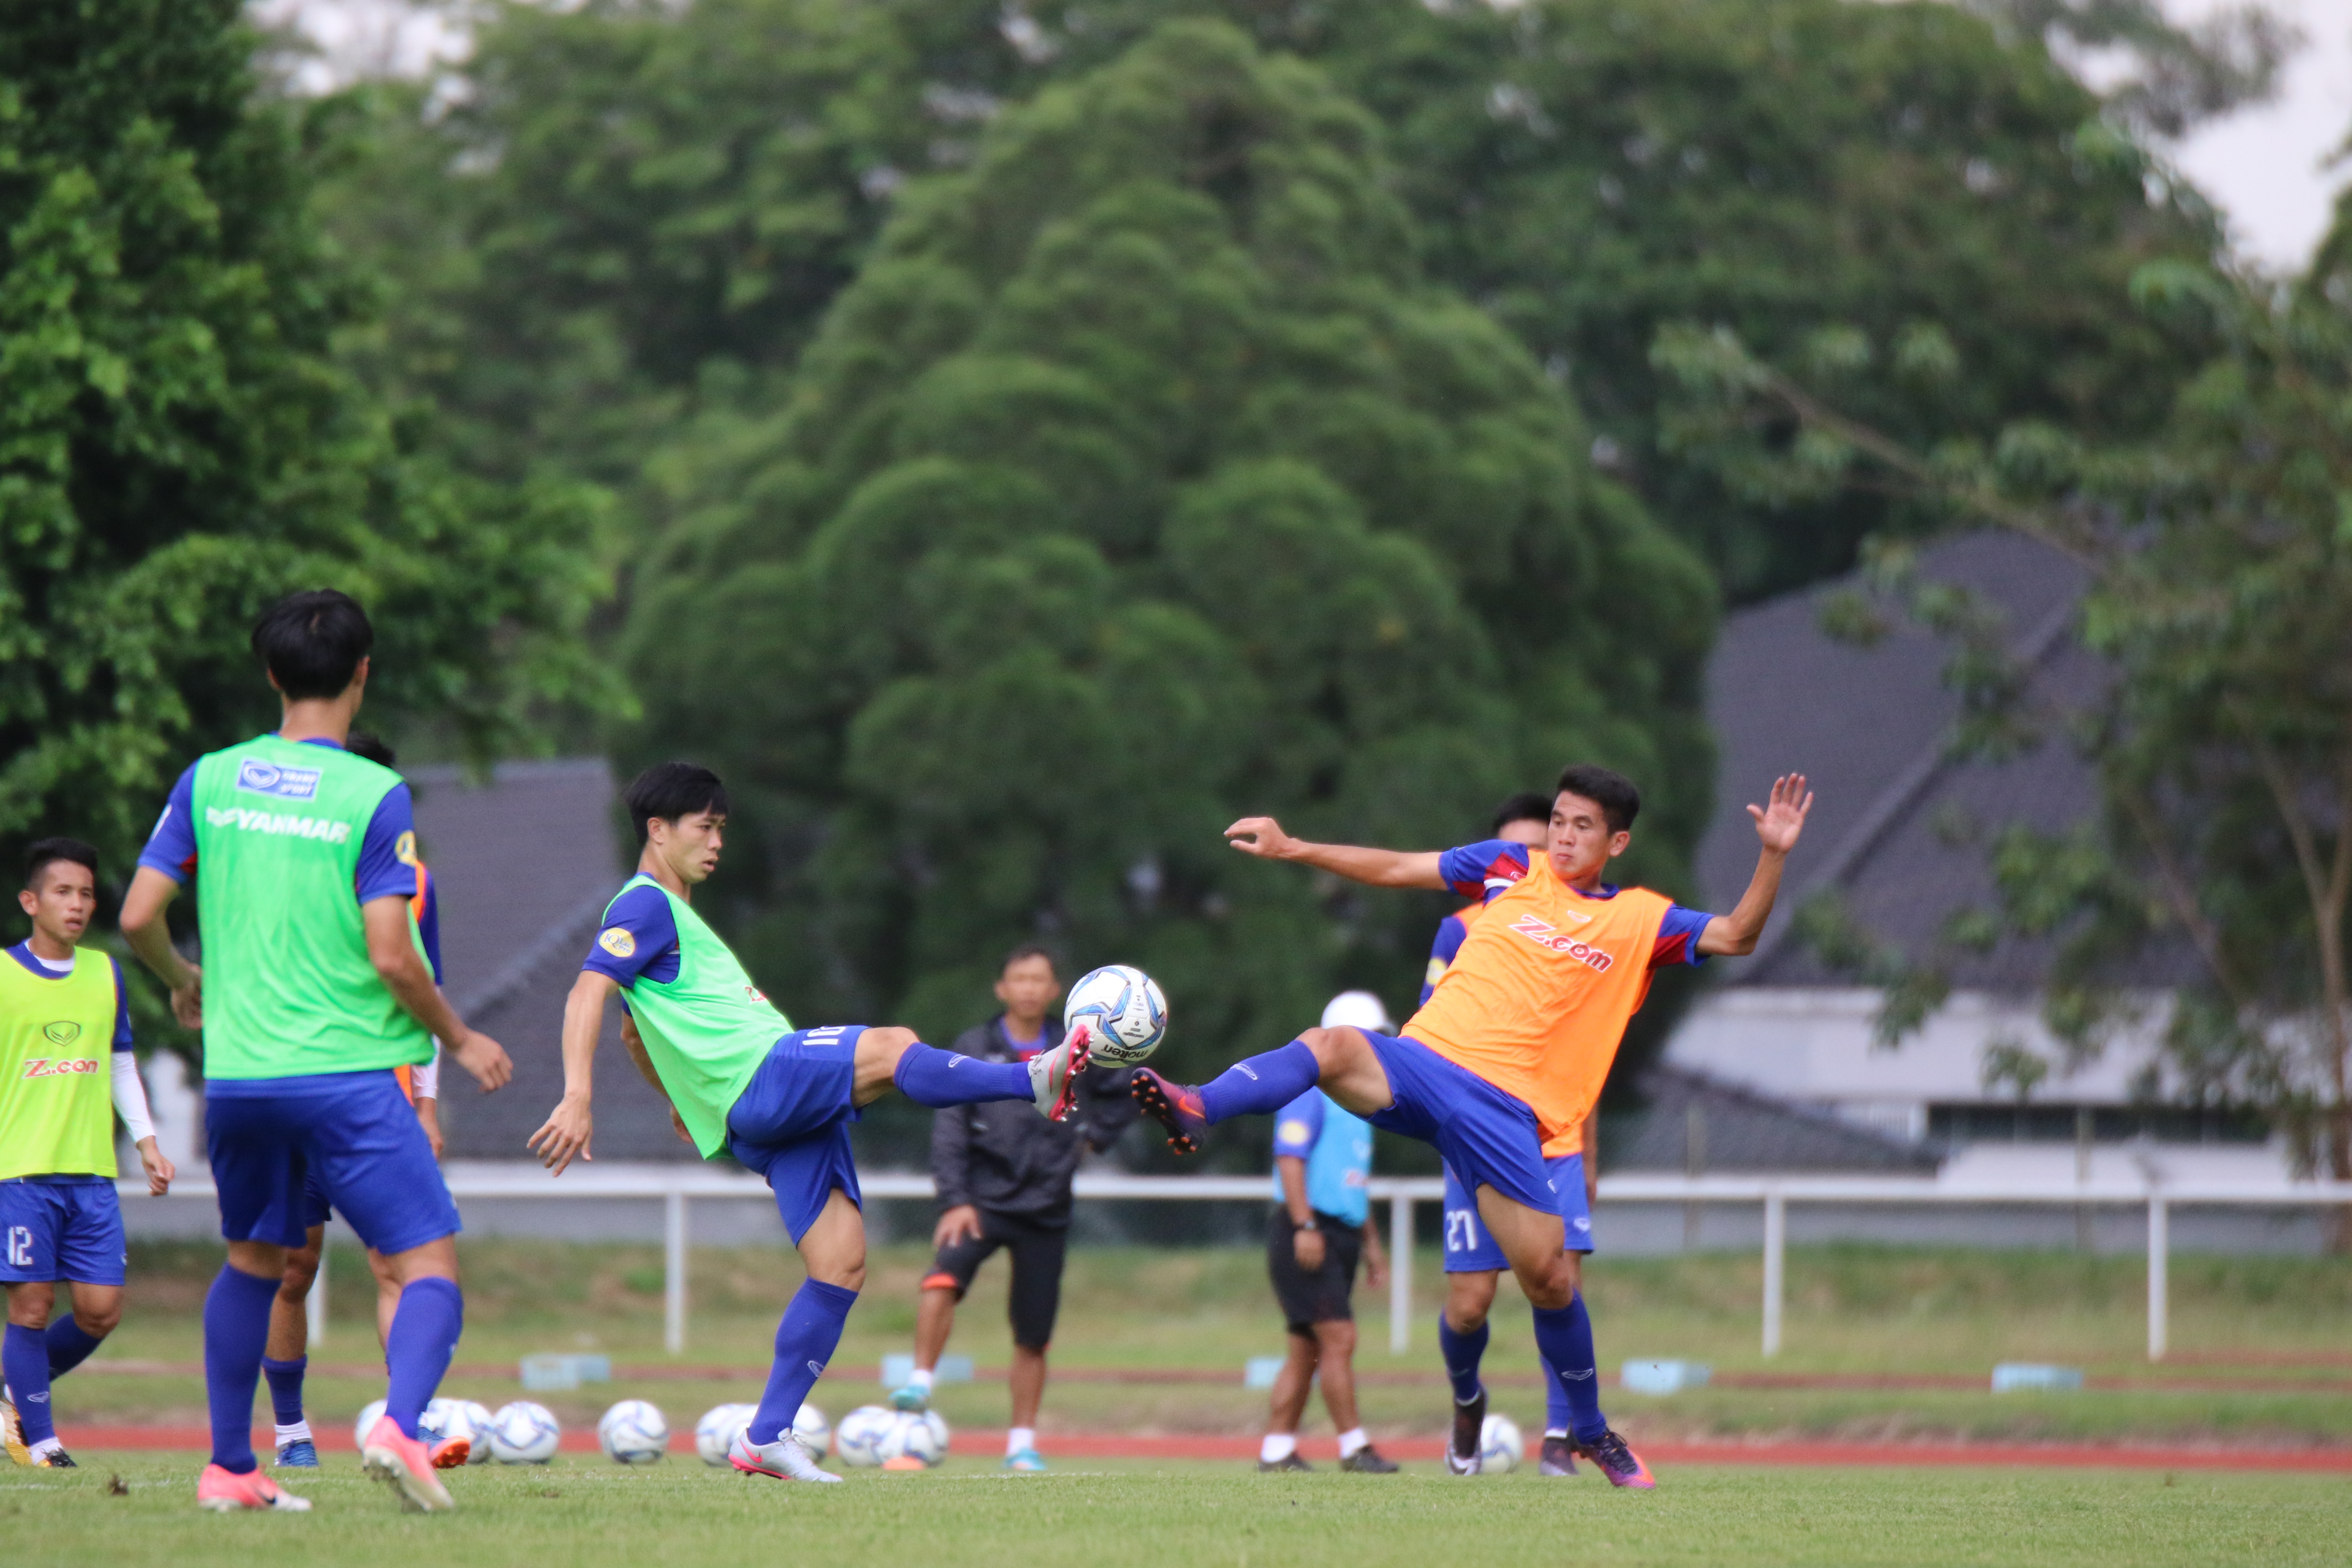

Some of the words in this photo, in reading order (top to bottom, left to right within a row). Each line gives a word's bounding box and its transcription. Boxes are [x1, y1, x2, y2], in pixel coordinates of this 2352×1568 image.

[236, 807, 352, 844] YANMAR
[603, 933, 620, 949] IQ
[1507, 914, 1614, 973] Z.com
[802, 1026, 846, 1046] 10
[1103, 1044, 1148, 1059] molten
[8, 1226, 33, 1265] 12
[1446, 1210, 1477, 1251] 27
